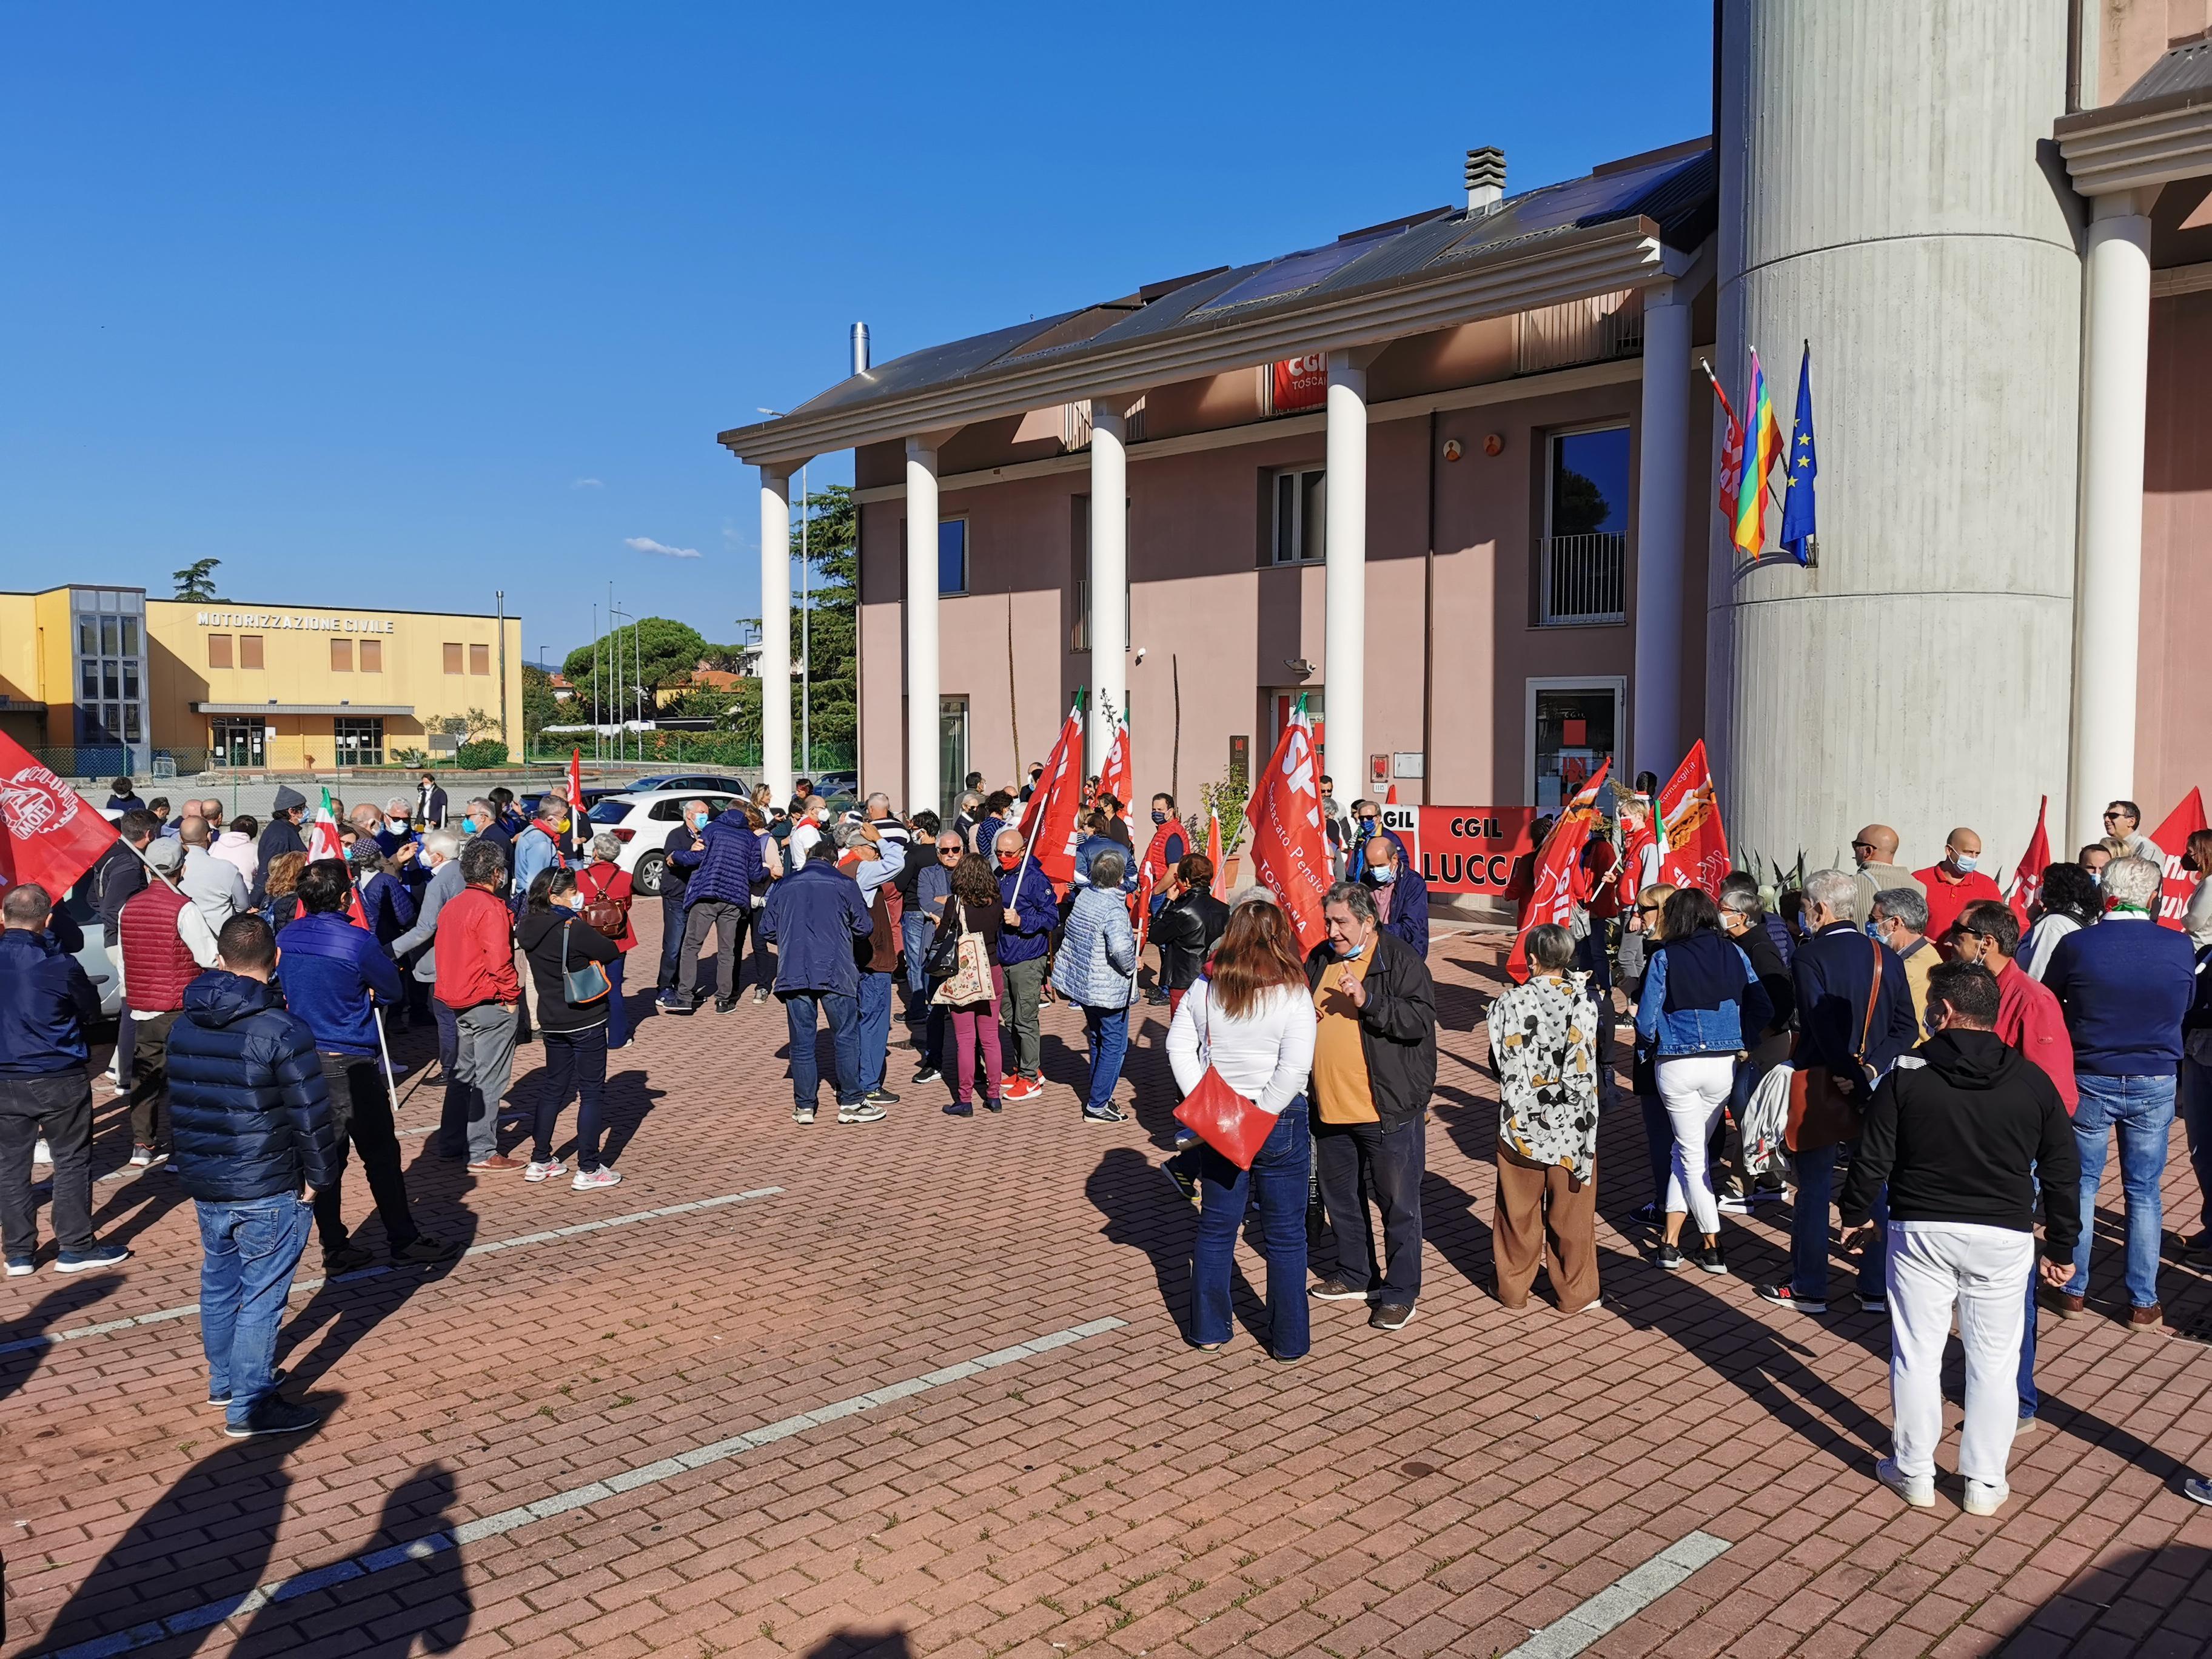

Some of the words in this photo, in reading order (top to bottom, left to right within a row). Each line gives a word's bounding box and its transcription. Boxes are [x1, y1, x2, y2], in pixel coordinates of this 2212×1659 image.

[1289, 352, 1328, 376] CGI
[1292, 377, 1326, 390] TOSCA
[198, 612, 341, 631] MOTORIZZAZIONE
[344, 620, 394, 633] CIVILE
[1383, 811, 1414, 828] GIL
[1450, 817, 1504, 839] CGIL
[1268, 781, 1290, 847] Sindacato
[1290, 845, 1324, 894] Pensio
[1423, 852, 1522, 886] LUCC
[1261, 859, 1308, 934] TOSCANA
